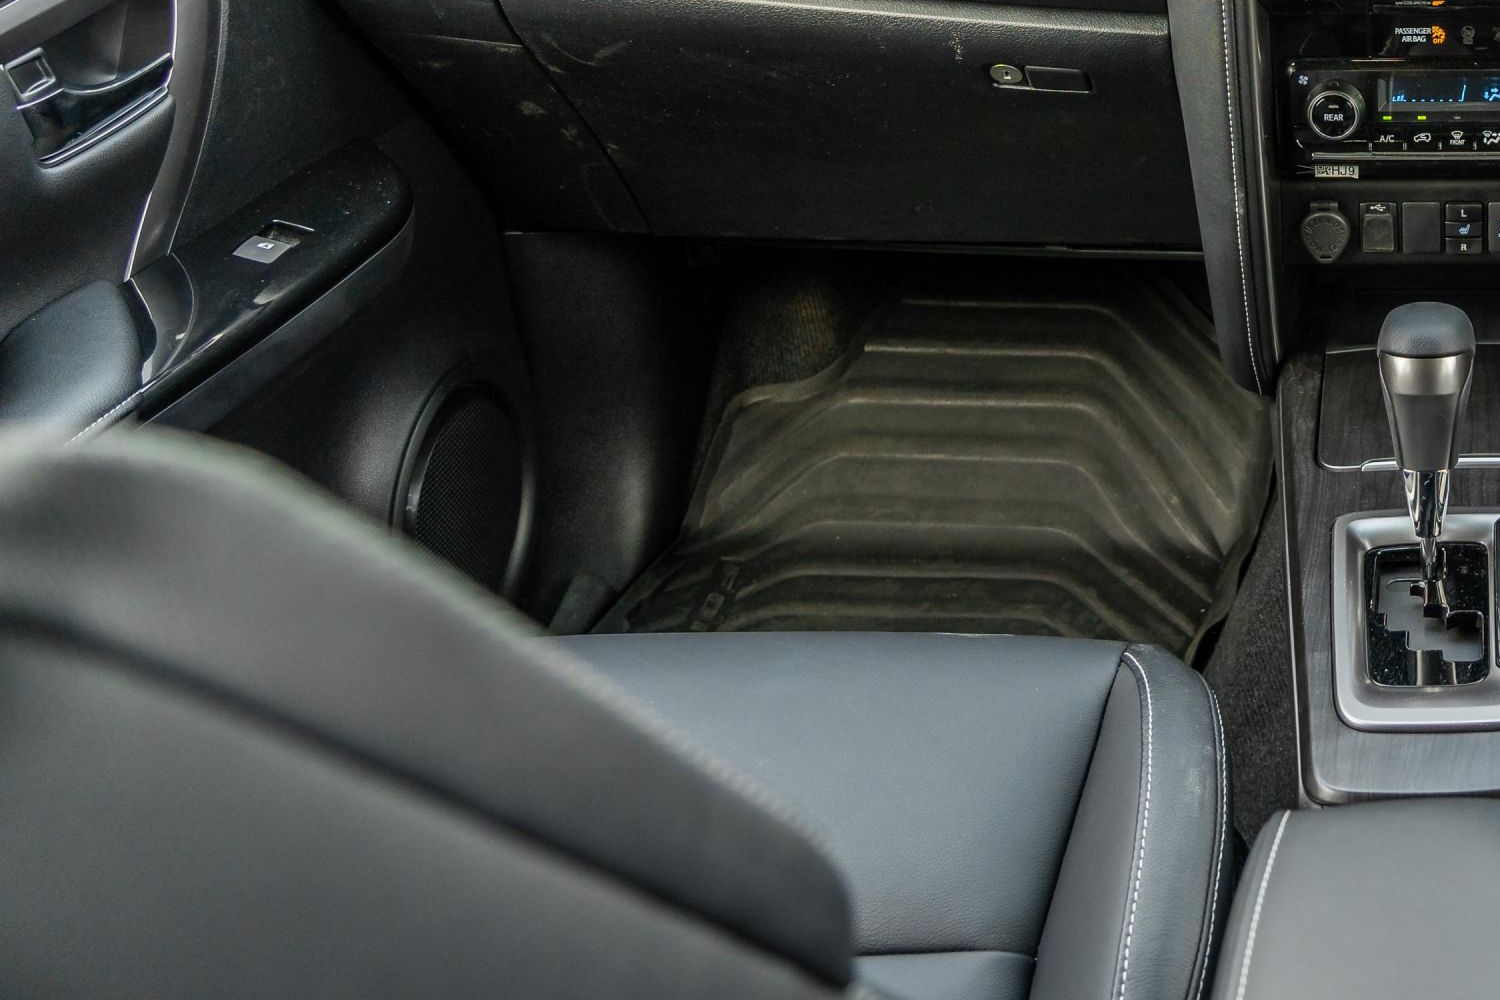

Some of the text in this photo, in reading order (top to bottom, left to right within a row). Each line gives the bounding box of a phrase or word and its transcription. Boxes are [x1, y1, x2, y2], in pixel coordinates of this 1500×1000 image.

[1394, 27, 1431, 35] PASSENGER
[1323, 113, 1344, 121] REAR
[1379, 134, 1395, 142] A/C
[1460, 209, 1467, 218] L
[1460, 243, 1467, 251] R
